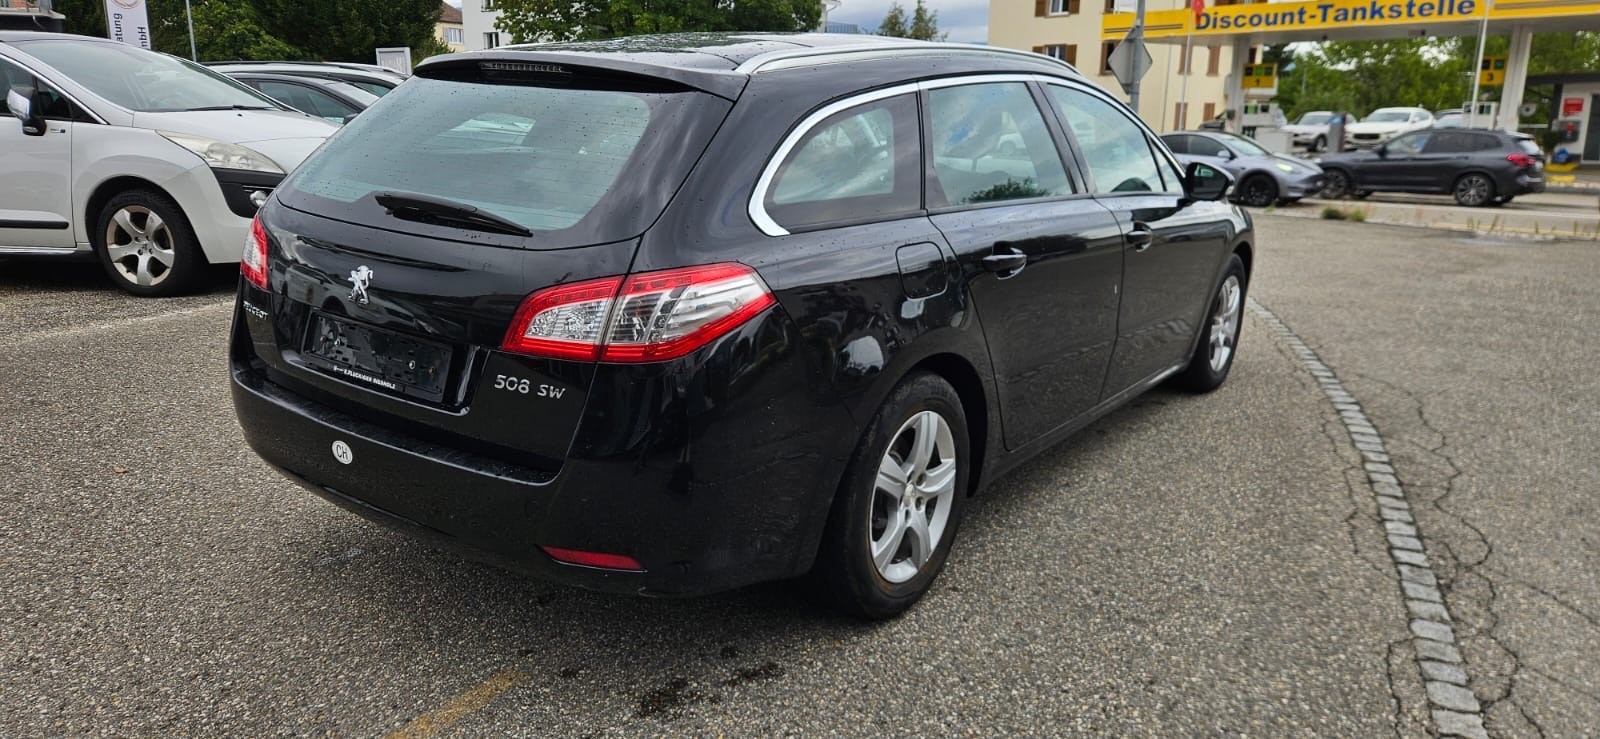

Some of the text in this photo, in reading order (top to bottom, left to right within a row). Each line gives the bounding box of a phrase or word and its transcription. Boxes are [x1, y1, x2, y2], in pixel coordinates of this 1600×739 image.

[1195, 0, 1475, 30] Discount-Tankstelle
[494, 374, 566, 399] 508 SW
[336, 444, 349, 461] CH
